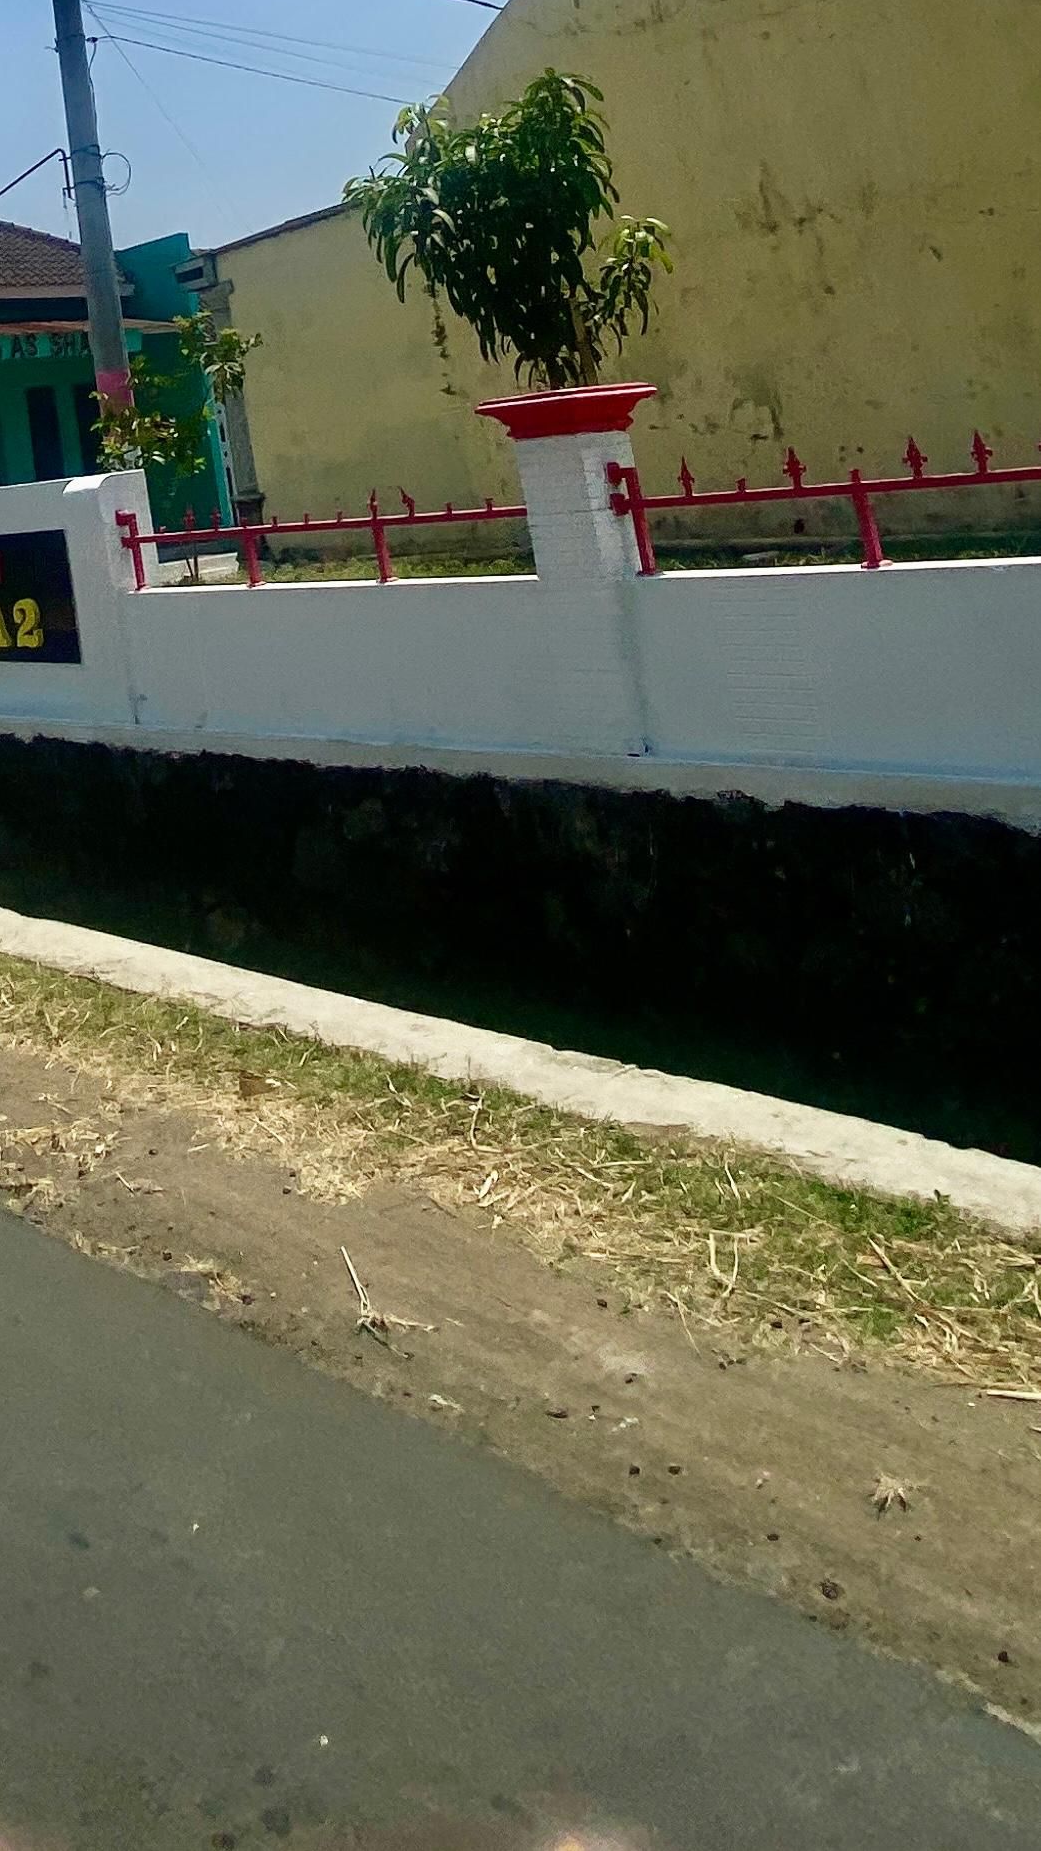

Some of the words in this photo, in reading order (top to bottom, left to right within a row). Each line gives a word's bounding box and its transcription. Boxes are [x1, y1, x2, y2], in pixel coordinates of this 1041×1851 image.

[12, 333, 38, 358] AS
[49, 331, 93, 358] SHA
[13, 598, 44, 648] 2
